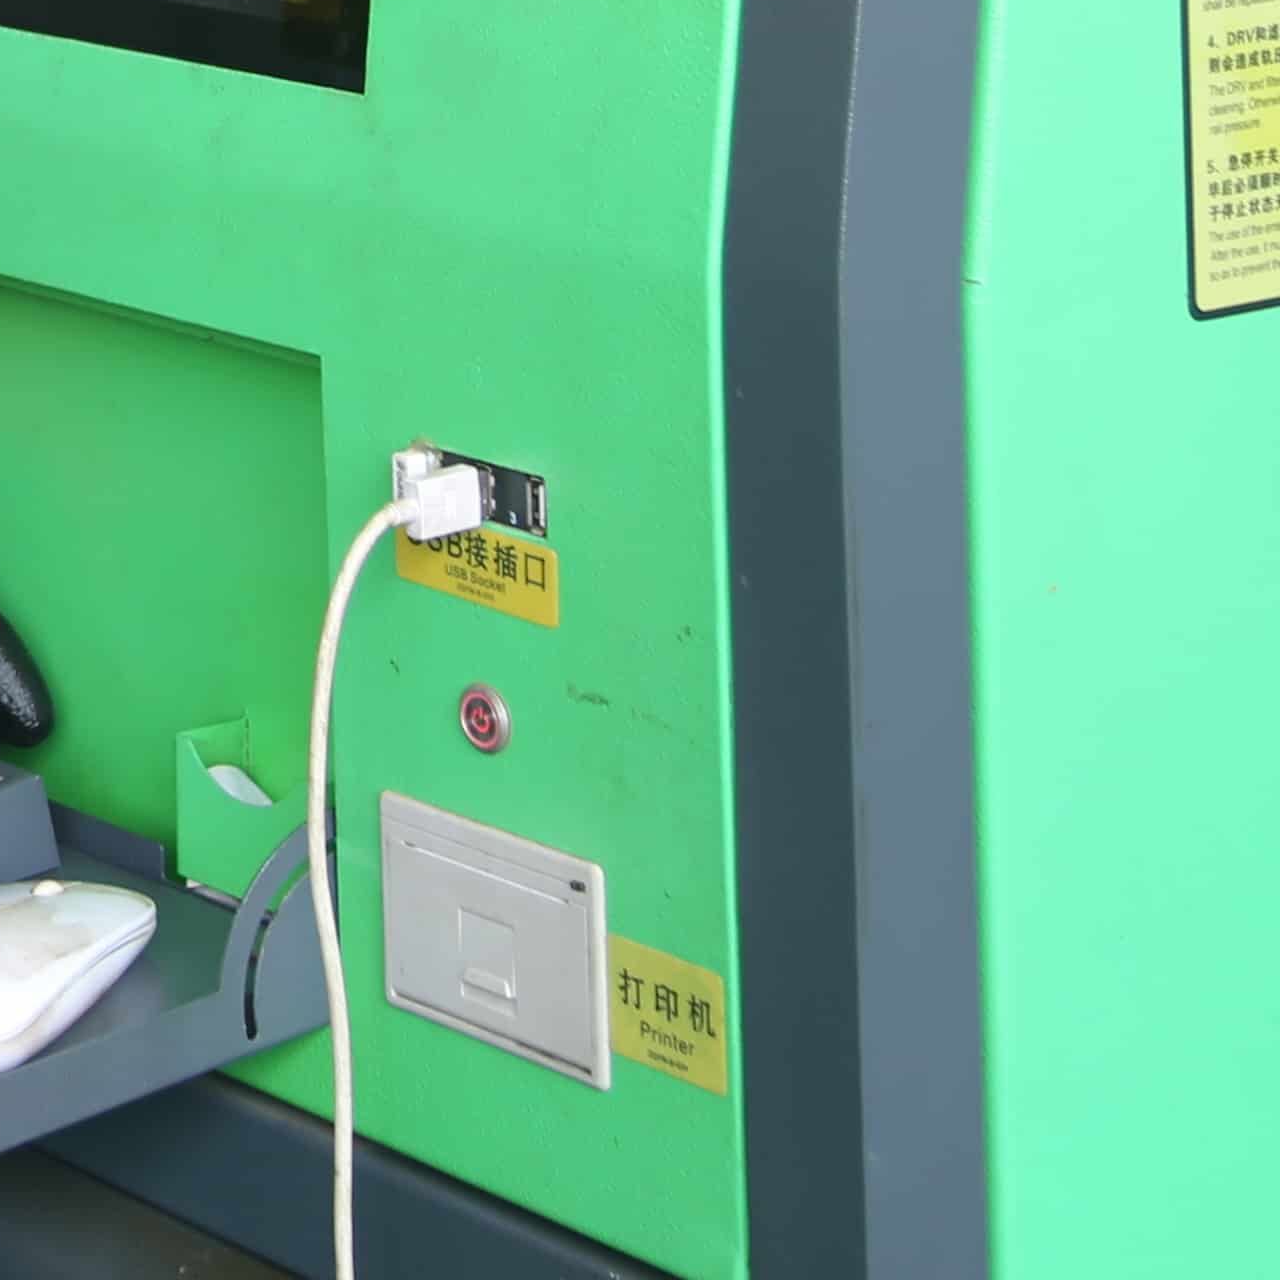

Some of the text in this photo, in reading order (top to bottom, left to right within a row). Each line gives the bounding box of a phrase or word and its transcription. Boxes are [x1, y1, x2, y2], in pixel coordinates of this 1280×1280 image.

[618, 968, 716, 1038] 打印机
[640, 1020, 696, 1056] Printer
